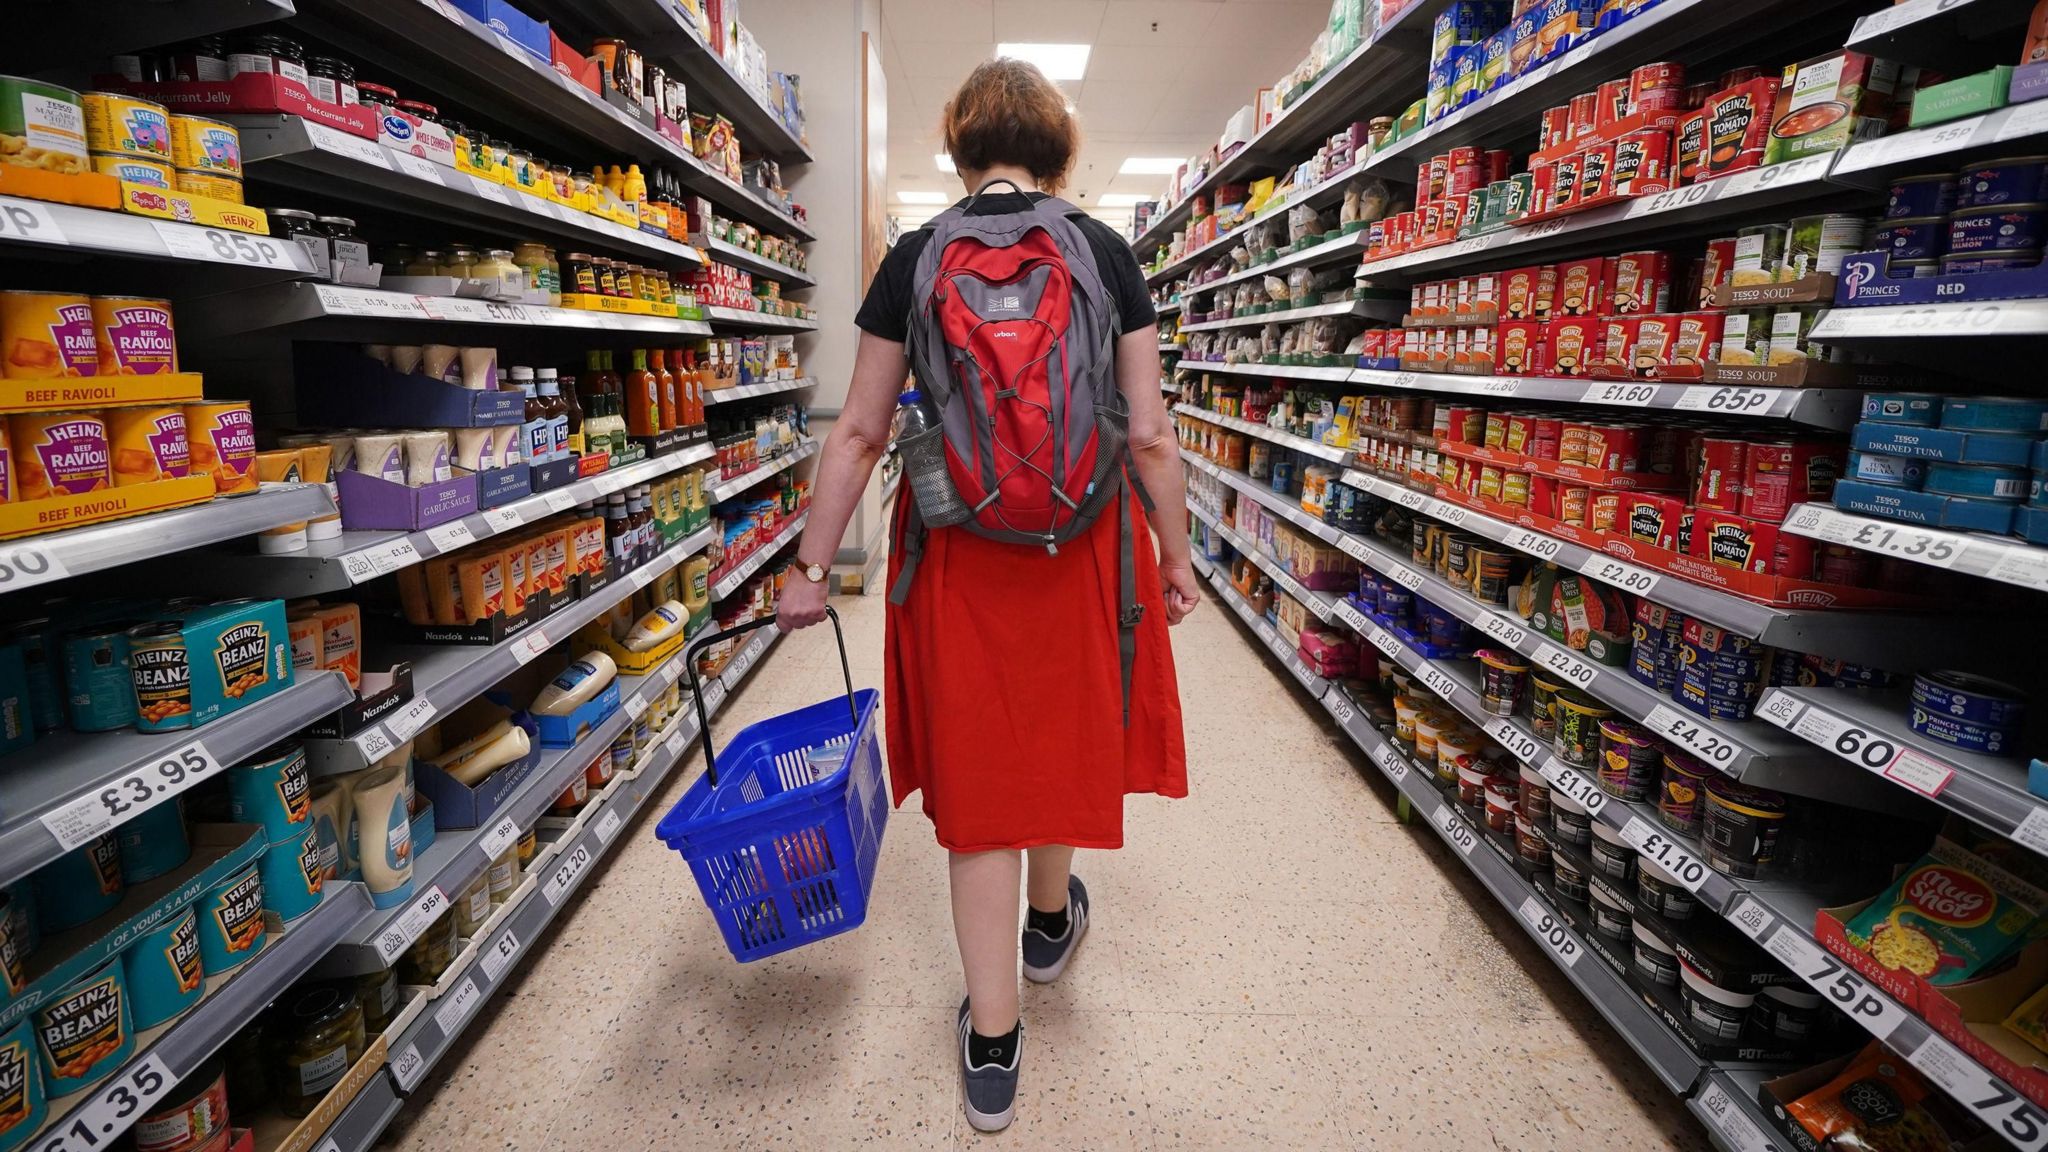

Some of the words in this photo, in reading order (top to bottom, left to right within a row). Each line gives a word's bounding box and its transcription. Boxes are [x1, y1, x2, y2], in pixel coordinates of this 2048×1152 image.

[1797, 78, 1806, 91] 5
[204, 92, 231, 104] Jelly
[1718, 98, 1747, 114] HEINZ
[136, 110, 165, 126] HEINZ
[1713, 117, 1748, 134] TOMATO
[210, 131, 237, 143] HEINZ
[416, 131, 430, 144] WHOLE
[1933, 126, 1972, 143] 55p
[122, 167, 161, 180] HEINZ
[1642, 186, 1666, 194] HEINZ
[1648, 185, 1706, 211] £1.10
[223, 214, 256, 230] HEINZ
[1954, 218, 1991, 228] PRINCES
[206, 229, 278, 264] 85p
[1952, 241, 1982, 249] SALMON
[1733, 290, 1759, 299] TESCO
[1762, 288, 1794, 299] SOUP
[1859, 286, 1900, 295] PRINCES
[1937, 283, 1965, 295] RED
[121, 311, 167, 325] HEINZ
[486, 303, 526, 321] £1.70
[1563, 328, 1579, 337] HEINZ
[120, 337, 172, 349] RAVIOLI
[1718, 369, 1743, 379] TESCO
[1747, 370, 1777, 382] SOUP
[25, 390, 58, 402] BEEF
[62, 388, 115, 400] RAVIOLI
[1602, 385, 1653, 400] £1.60
[1707, 387, 1767, 411] 65p
[52, 424, 102, 441] HEINZ
[534, 428, 547, 444] HP
[556, 425, 568, 440] HP
[1563, 431, 1588, 440] HEINZ
[1894, 434, 1919, 442] TESCO
[1868, 442, 1912, 454] DRAINED
[1914, 447, 1944, 458] TUNA
[51, 451, 107, 467] RAVIOLI
[500, 474, 515, 483] TESCO
[1810, 470, 1833, 478] TOMATO
[1865, 467, 1895, 475] STEAKS
[1507, 476, 1528, 484] HEINZ
[439, 489, 456, 498] TESCO
[1400, 493, 1422, 506] 65p
[38, 508, 69, 523] BEEF
[74, 499, 127, 517] RAVIOLI
[424, 502, 450, 516] GARLIC
[450, 495, 471, 506] SAUCE
[1436, 505, 1464, 521] £1.60
[1636, 506, 1659, 519] HEINZ
[1805, 509, 1822, 518] 12R
[1850, 501, 1894, 516] DRAINED
[1896, 509, 1925, 521] TUNA
[502, 511, 516, 521] 95p
[1796, 515, 1819, 527] 01D
[449, 526, 468, 538] £1.35
[1633, 520, 1658, 533] TOMATO
[1719, 527, 1746, 539] HEINZ
[1518, 533, 1557, 555] £1.60
[1609, 542, 1632, 556] HEINZ
[1713, 542, 1747, 557] TOMATO
[1853, 524, 1953, 560] £1.35
[391, 544, 412, 557] £1.25
[1350, 544, 1370, 560] £1.35
[349, 561, 369, 573] 02D
[1668, 562, 1699, 576] FAVOURITE
[1701, 571, 1727, 585] RECIPES
[1677, 557, 1688, 565] THE
[1689, 561, 1717, 575] NATION'S
[729, 574, 739, 588] £3
[1396, 570, 1421, 588] £1.35
[1600, 565, 1652, 590] £2.80
[1562, 582, 1576, 591] JOHN
[1565, 589, 1579, 597] WEST
[550, 596, 570, 610] Nando's
[1792, 592, 1832, 605] HEINZ
[1346, 608, 1365, 628] £1.05
[1638, 611, 1649, 620] PACK
[505, 616, 529, 636] Nando's
[1487, 617, 1522, 644] £2.80
[1691, 625, 1696, 633] 4
[226, 627, 258, 646] HEINZ
[425, 632, 463, 641] Nando's
[1376, 633, 1399, 655] £1.05
[1685, 632, 1699, 641] PACK
[137, 650, 180, 664] HEINZ
[221, 639, 265, 666] BEANZ
[734, 656, 747, 674] 90p
[1548, 653, 1592, 682] £2.80
[134, 667, 190, 686] BEANZ
[1425, 671, 1454, 694] £1.10
[1684, 677, 1706, 691] CHUNKS
[362, 694, 400, 721] Nando's
[409, 700, 428, 718] £2.10
[1770, 702, 1792, 718] 01C
[1778, 697, 1795, 708] 12R
[1928, 715, 1961, 730] PRINCES
[1497, 725, 1535, 757] £1.10
[1668, 720, 1732, 761] £4.20
[1928, 723, 1949, 735] TUNA
[1950, 728, 1984, 743] CHUNKS
[366, 736, 386, 752] 02C
[1836, 728, 1895, 768] 60
[1383, 752, 1405, 776] 90p
[101, 748, 208, 817] £3.95
[1555, 768, 1604, 809] £1.10
[498, 821, 513, 838] 95p
[1445, 818, 1472, 847] 90p
[1642, 834, 1704, 883] £1.10
[556, 848, 586, 888] £2.20
[1591, 874, 1635, 914] #YOUCANMAKEIT
[421, 892, 440, 913] 95p
[112, 933, 129, 946] OF
[132, 910, 162, 933] YOUR
[165, 903, 172, 913] 5
[173, 896, 183, 907] A
[183, 882, 202, 901] DAY
[1742, 910, 1762, 928] 01B
[1751, 906, 1765, 918] 12R
[383, 932, 395, 942] 12L
[384, 934, 402, 952] 02B
[1537, 915, 1575, 955] 90p
[498, 934, 516, 957] £1
[1586, 933, 1626, 975] #YOUCANMAKEIT
[1676, 944, 1694, 964] POT
[1751, 973, 1774, 983] POT
[1808, 955, 1883, 1017] 75p
[54, 981, 111, 1022] HEINZ
[456, 983, 474, 1005] £1.40
[46, 997, 118, 1046] BEANZ
[1738, 1049, 1763, 1059] POT
[400, 1053, 417, 1074] 02A
[319, 1047, 383, 1123] GHERKINS
[1708, 1096, 1726, 1115] 01A
[1713, 1091, 1729, 1106] 12R
[1852, 1085, 1889, 1115] FOOD
